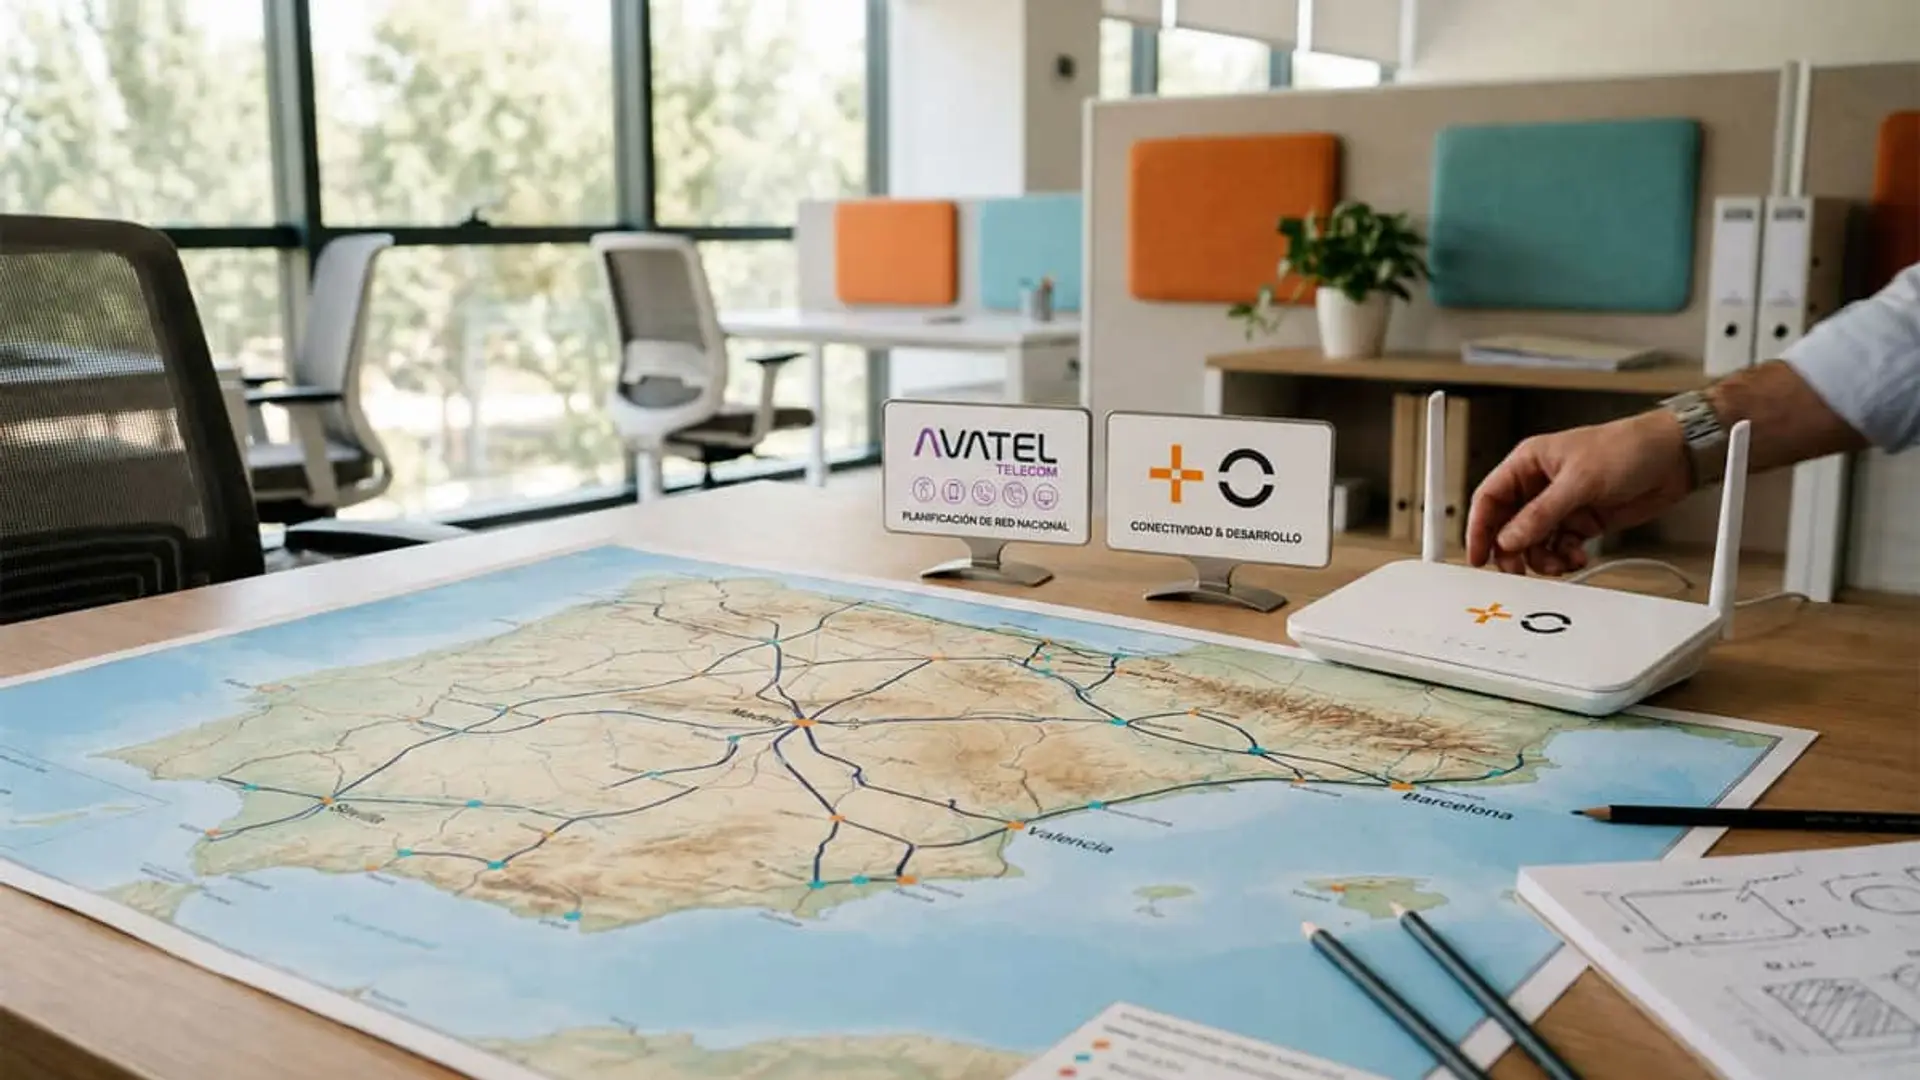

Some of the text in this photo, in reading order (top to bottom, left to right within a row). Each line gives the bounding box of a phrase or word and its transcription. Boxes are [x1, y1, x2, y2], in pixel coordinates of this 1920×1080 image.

[913, 428, 1057, 464] AVATEL
[996, 464, 1058, 477] TELECOM
[902, 510, 1070, 532] PLANIFICACIÓN DE RED NACIONAL
[1130, 520, 1302, 544] CONECTIVIDAD & DESARROLLO
[1402, 791, 1514, 821] Barcelona
[1028, 826, 1114, 854] Valencia
